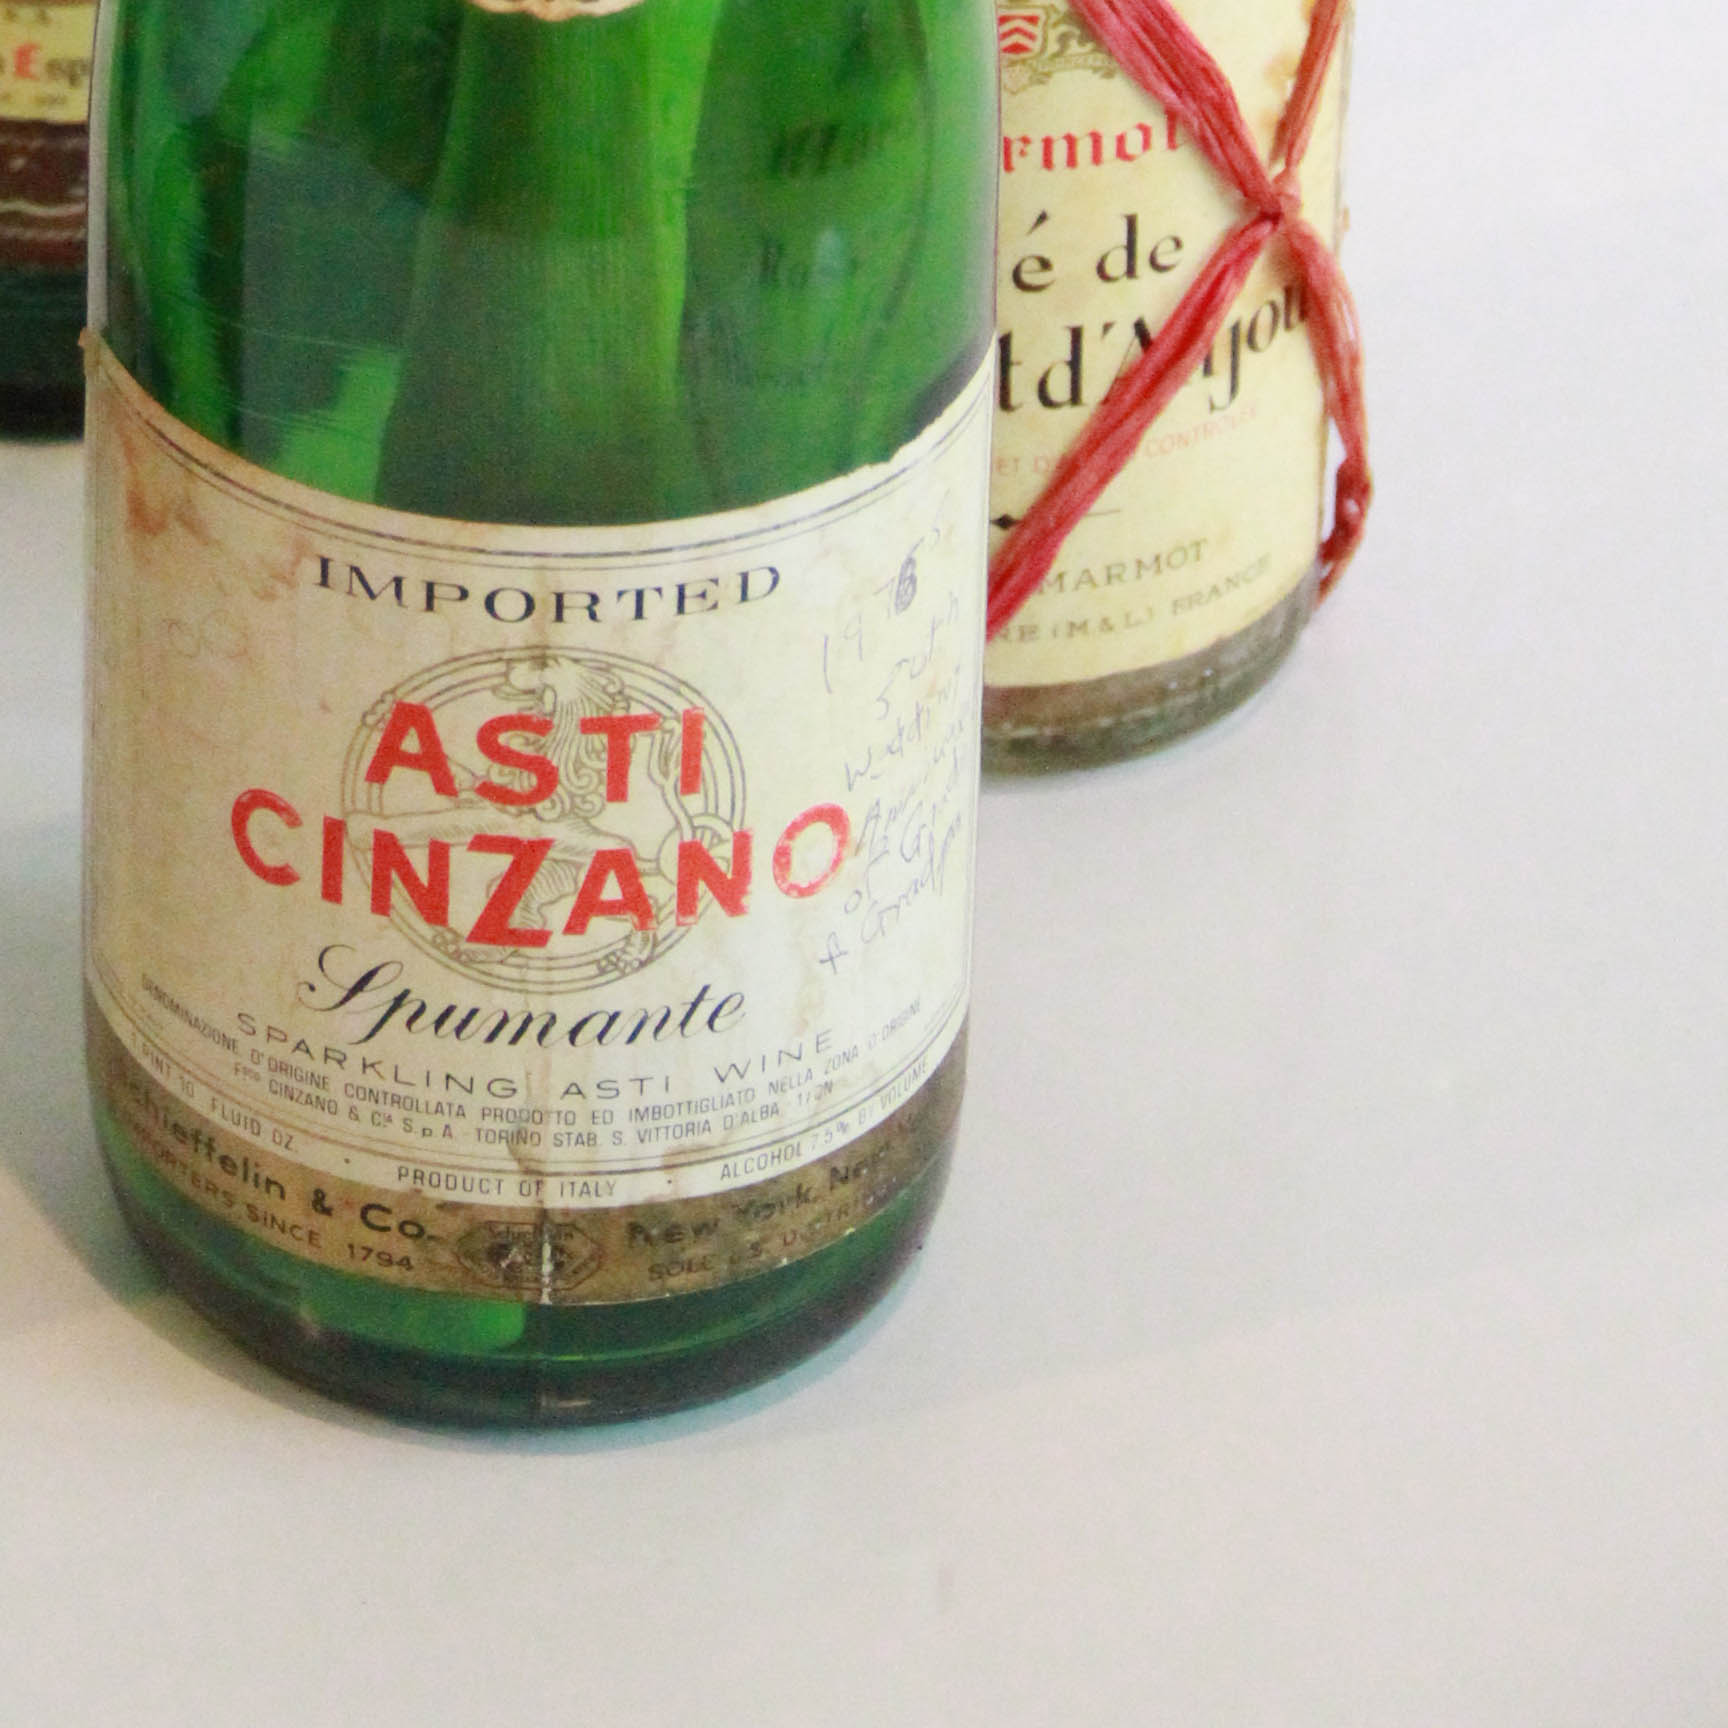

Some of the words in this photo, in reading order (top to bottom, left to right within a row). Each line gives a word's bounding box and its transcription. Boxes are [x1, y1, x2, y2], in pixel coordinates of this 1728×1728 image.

[1096, 214, 1183, 283] de
[313, 555, 784, 624] IMPORTED
[1040, 538, 1208, 596] MARMOT
[365, 701, 707, 809] ASTI
[230, 787, 854, 948] CINZANO
[297, 944, 747, 1045] Spumante
[237, 1011, 518, 1099] SPARKLING
[560, 1076, 671, 1100] ASTI
[713, 1028, 834, 1083] WINE
[344, 1081, 466, 1119] CONTROLLATA
[629, 1087, 756, 1122] IMBOTTIGLIATO
[768, 1068, 813, 1095] NELLA
[824, 1045, 859, 1076] ZONA
[211, 1096, 261, 1137] FLUID
[397, 1164, 505, 1197] PRODUCT
[519, 1179, 543, 1198] OF
[560, 1180, 617, 1198] ITALY
[719, 1141, 803, 1181] ALCOHOL
[269, 1078, 338, 1116] CINZANO
[348, 1106, 360, 1122] &
[476, 1127, 542, 1146] TORINO
[637, 1119, 712, 1145] VITTORIA
[245, 1201, 322, 1249] SINCE
[345, 1242, 415, 1272] 1794
[311, 1187, 334, 1218] &
